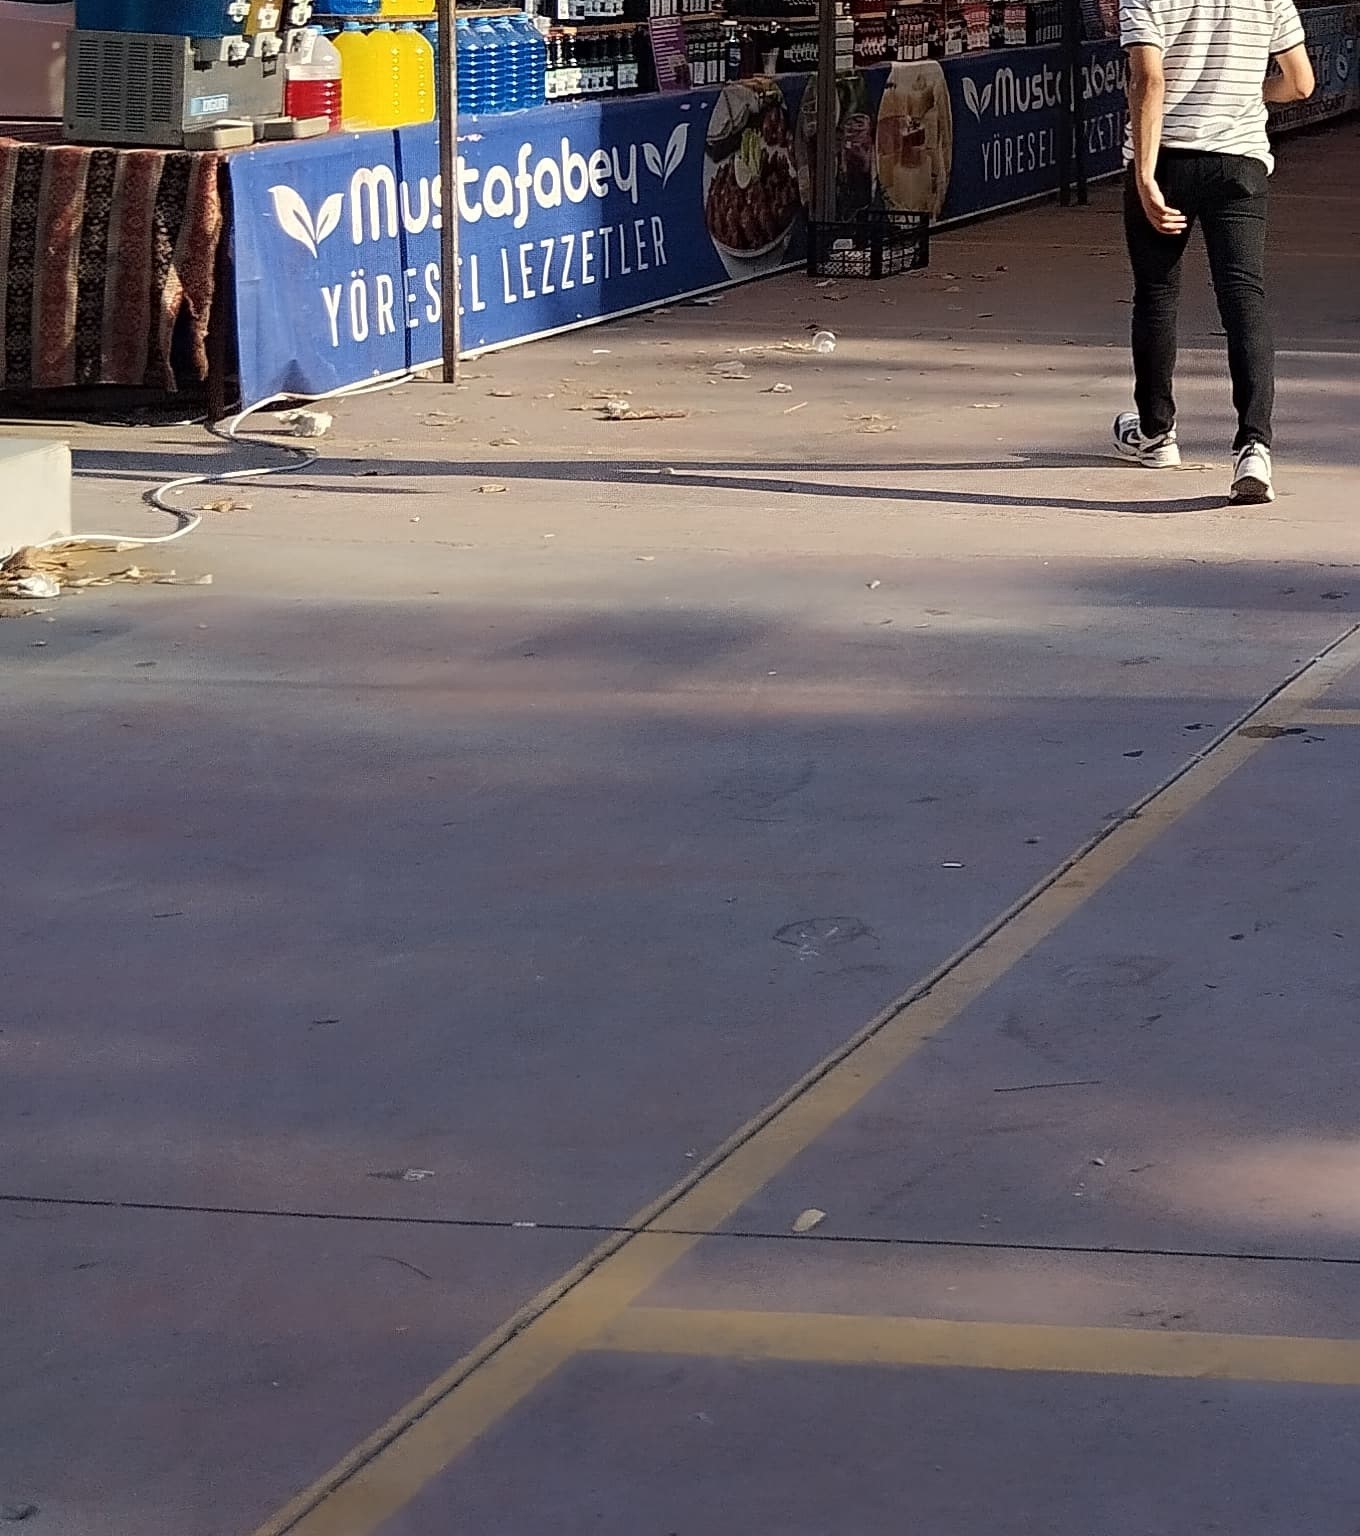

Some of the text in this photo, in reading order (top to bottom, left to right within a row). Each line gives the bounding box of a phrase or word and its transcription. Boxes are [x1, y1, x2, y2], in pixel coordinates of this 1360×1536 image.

[351, 137, 638, 244] Mustafabey
[982, 128, 1056, 182] YÖRESEL
[321, 216, 667, 347] YÖRESL LEZZETLER
